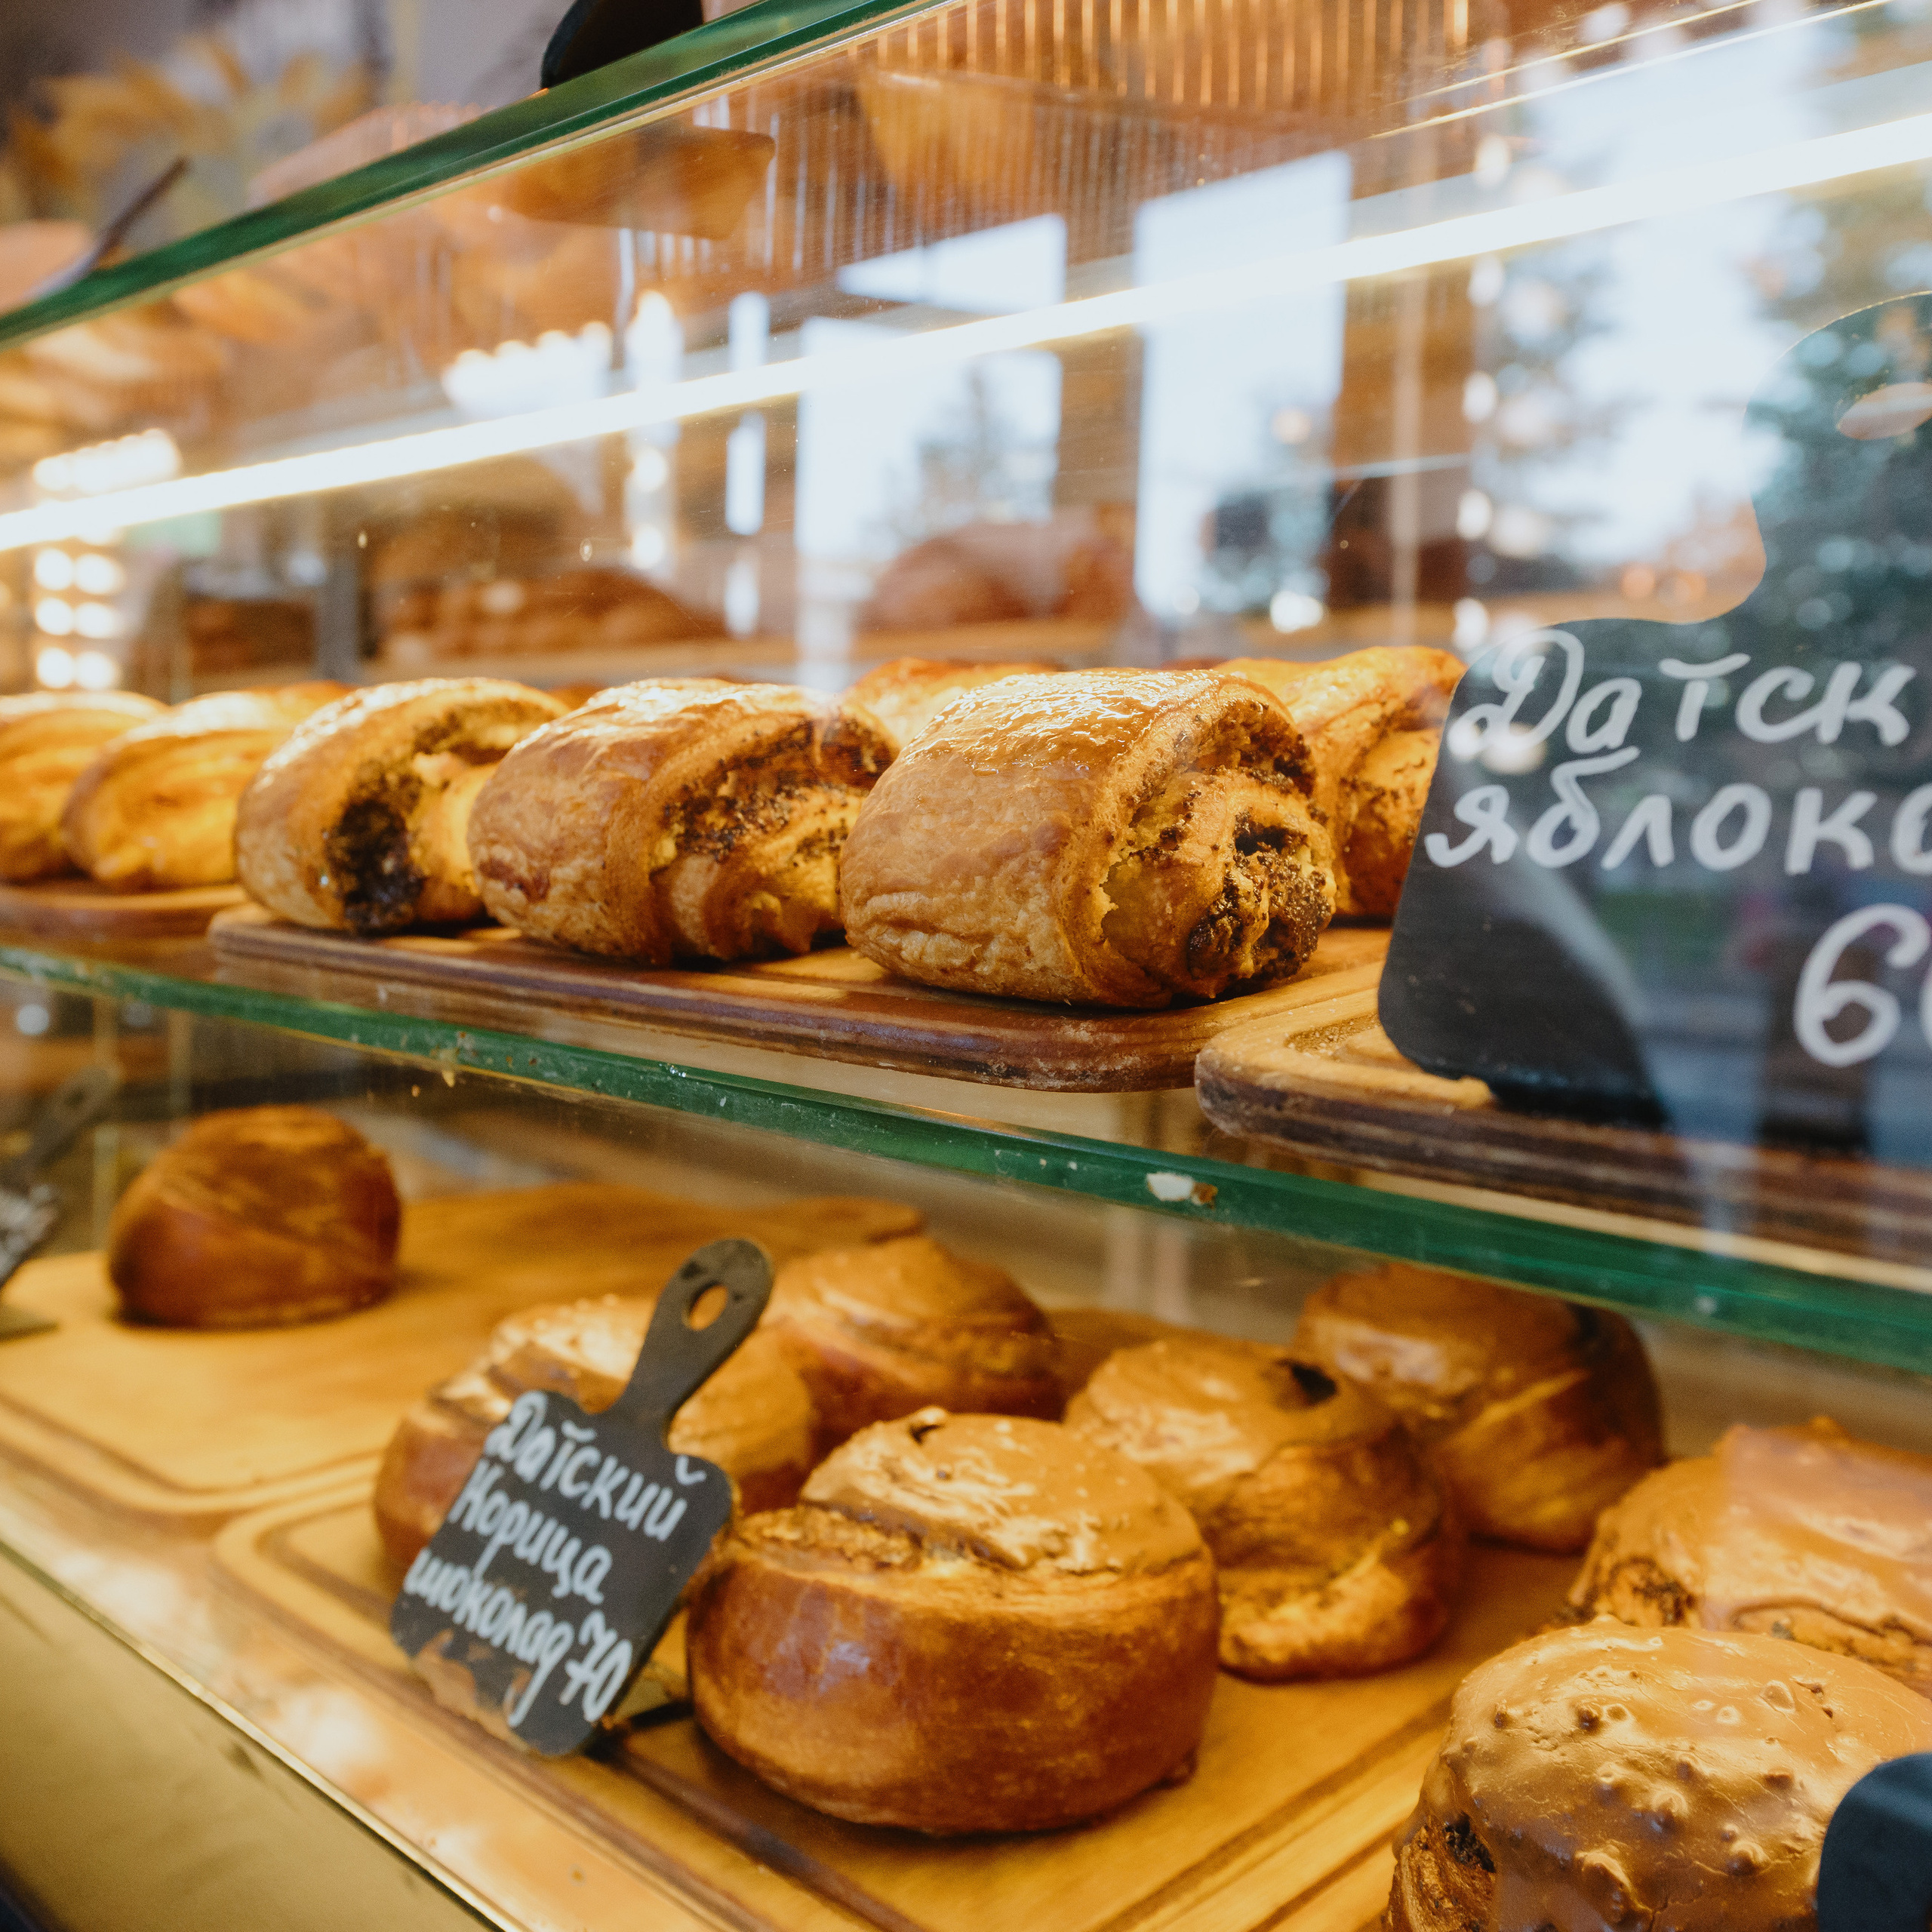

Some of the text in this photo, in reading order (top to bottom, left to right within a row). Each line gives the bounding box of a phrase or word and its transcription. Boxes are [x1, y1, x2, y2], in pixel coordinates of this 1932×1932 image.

[1794, 904, 1932, 1068] 6
[485, 1390, 706, 1541] Датский
[559, 1609, 633, 1722] 70
